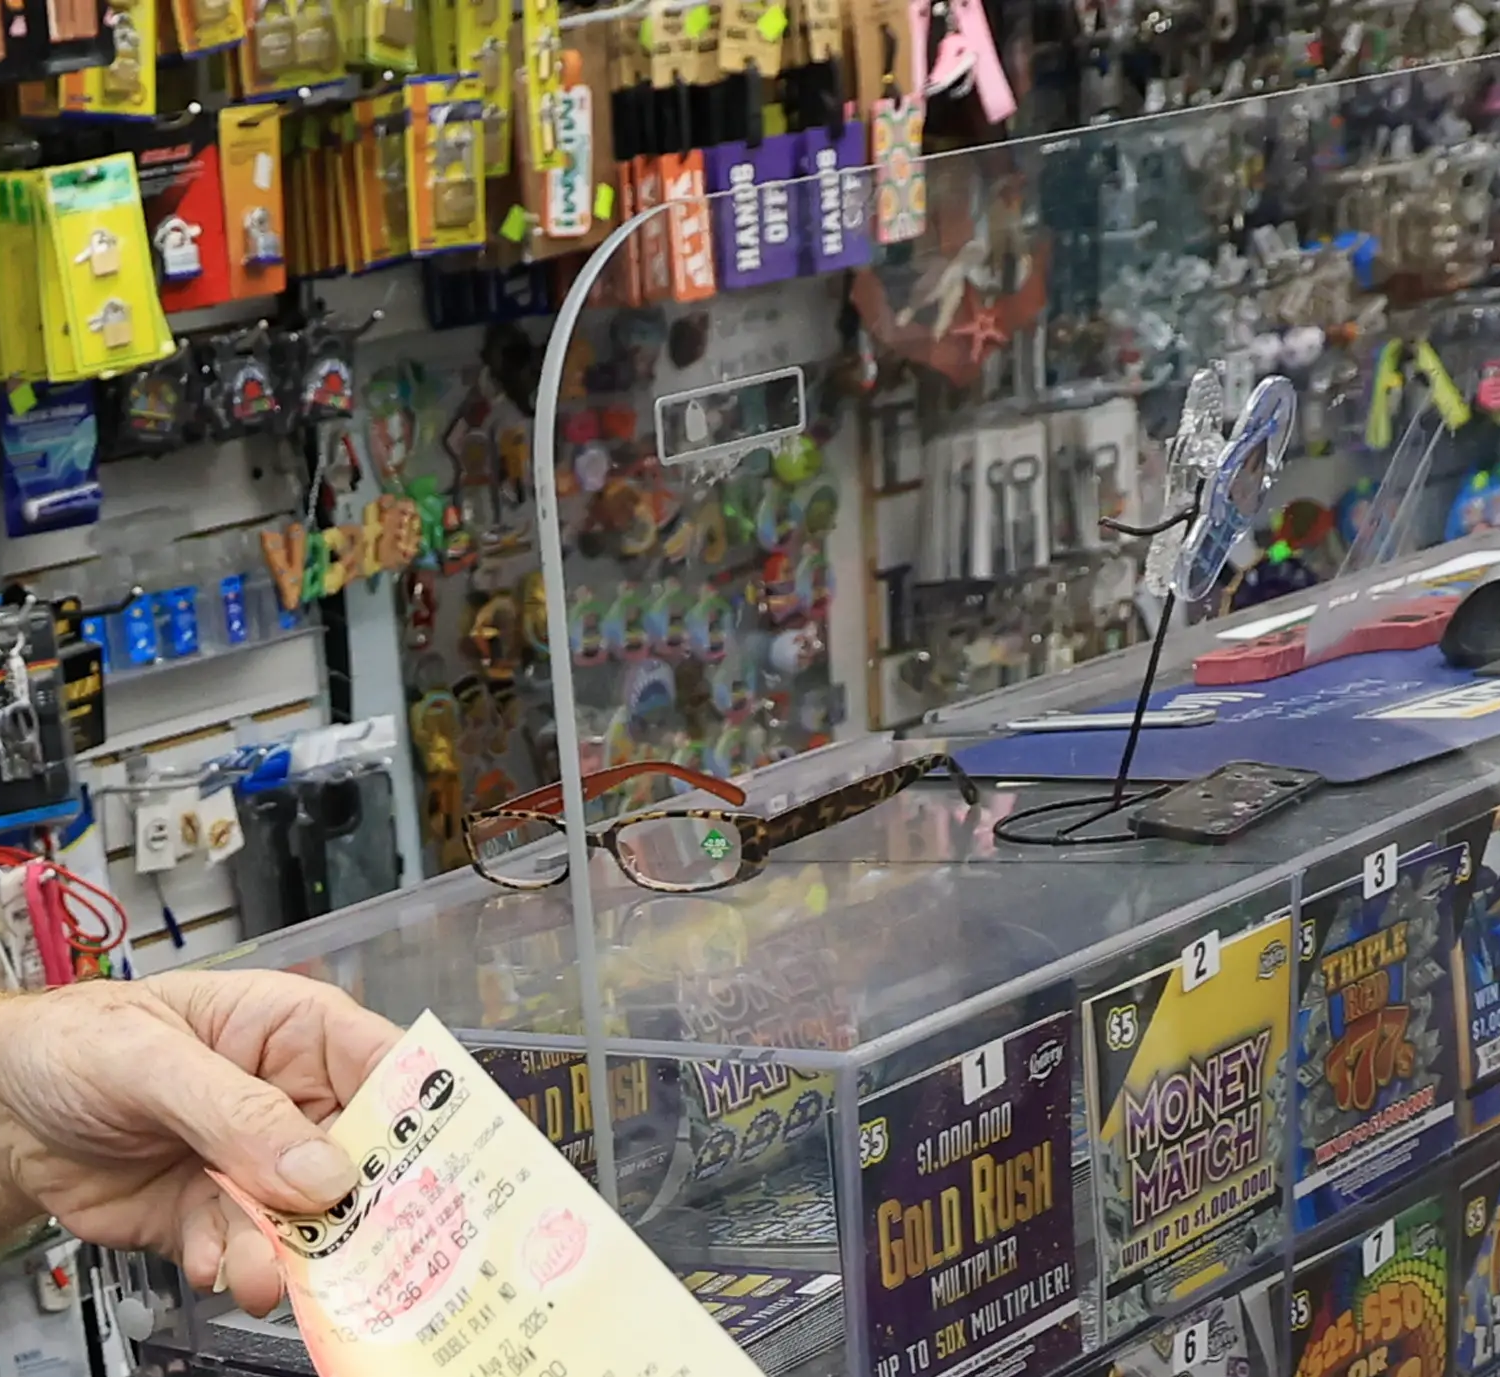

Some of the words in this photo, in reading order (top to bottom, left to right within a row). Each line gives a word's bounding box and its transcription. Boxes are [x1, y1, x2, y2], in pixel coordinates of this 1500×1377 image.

[730, 163, 761, 272] HANDS
[1321, 920, 1409, 992] TRIPLE
[1124, 1029, 1271, 1160] MONEY
[876, 1179, 963, 1292] GOLD
[970, 1140, 1053, 1238] RUSH
[1130, 1103, 1264, 1229] MATCH
[903, 1342, 934, 1377] TO
[935, 1319, 969, 1359] 50X
[970, 1268, 1073, 1343] MULTIPLIER!
[930, 1236, 1020, 1315] MULTIPLIER
